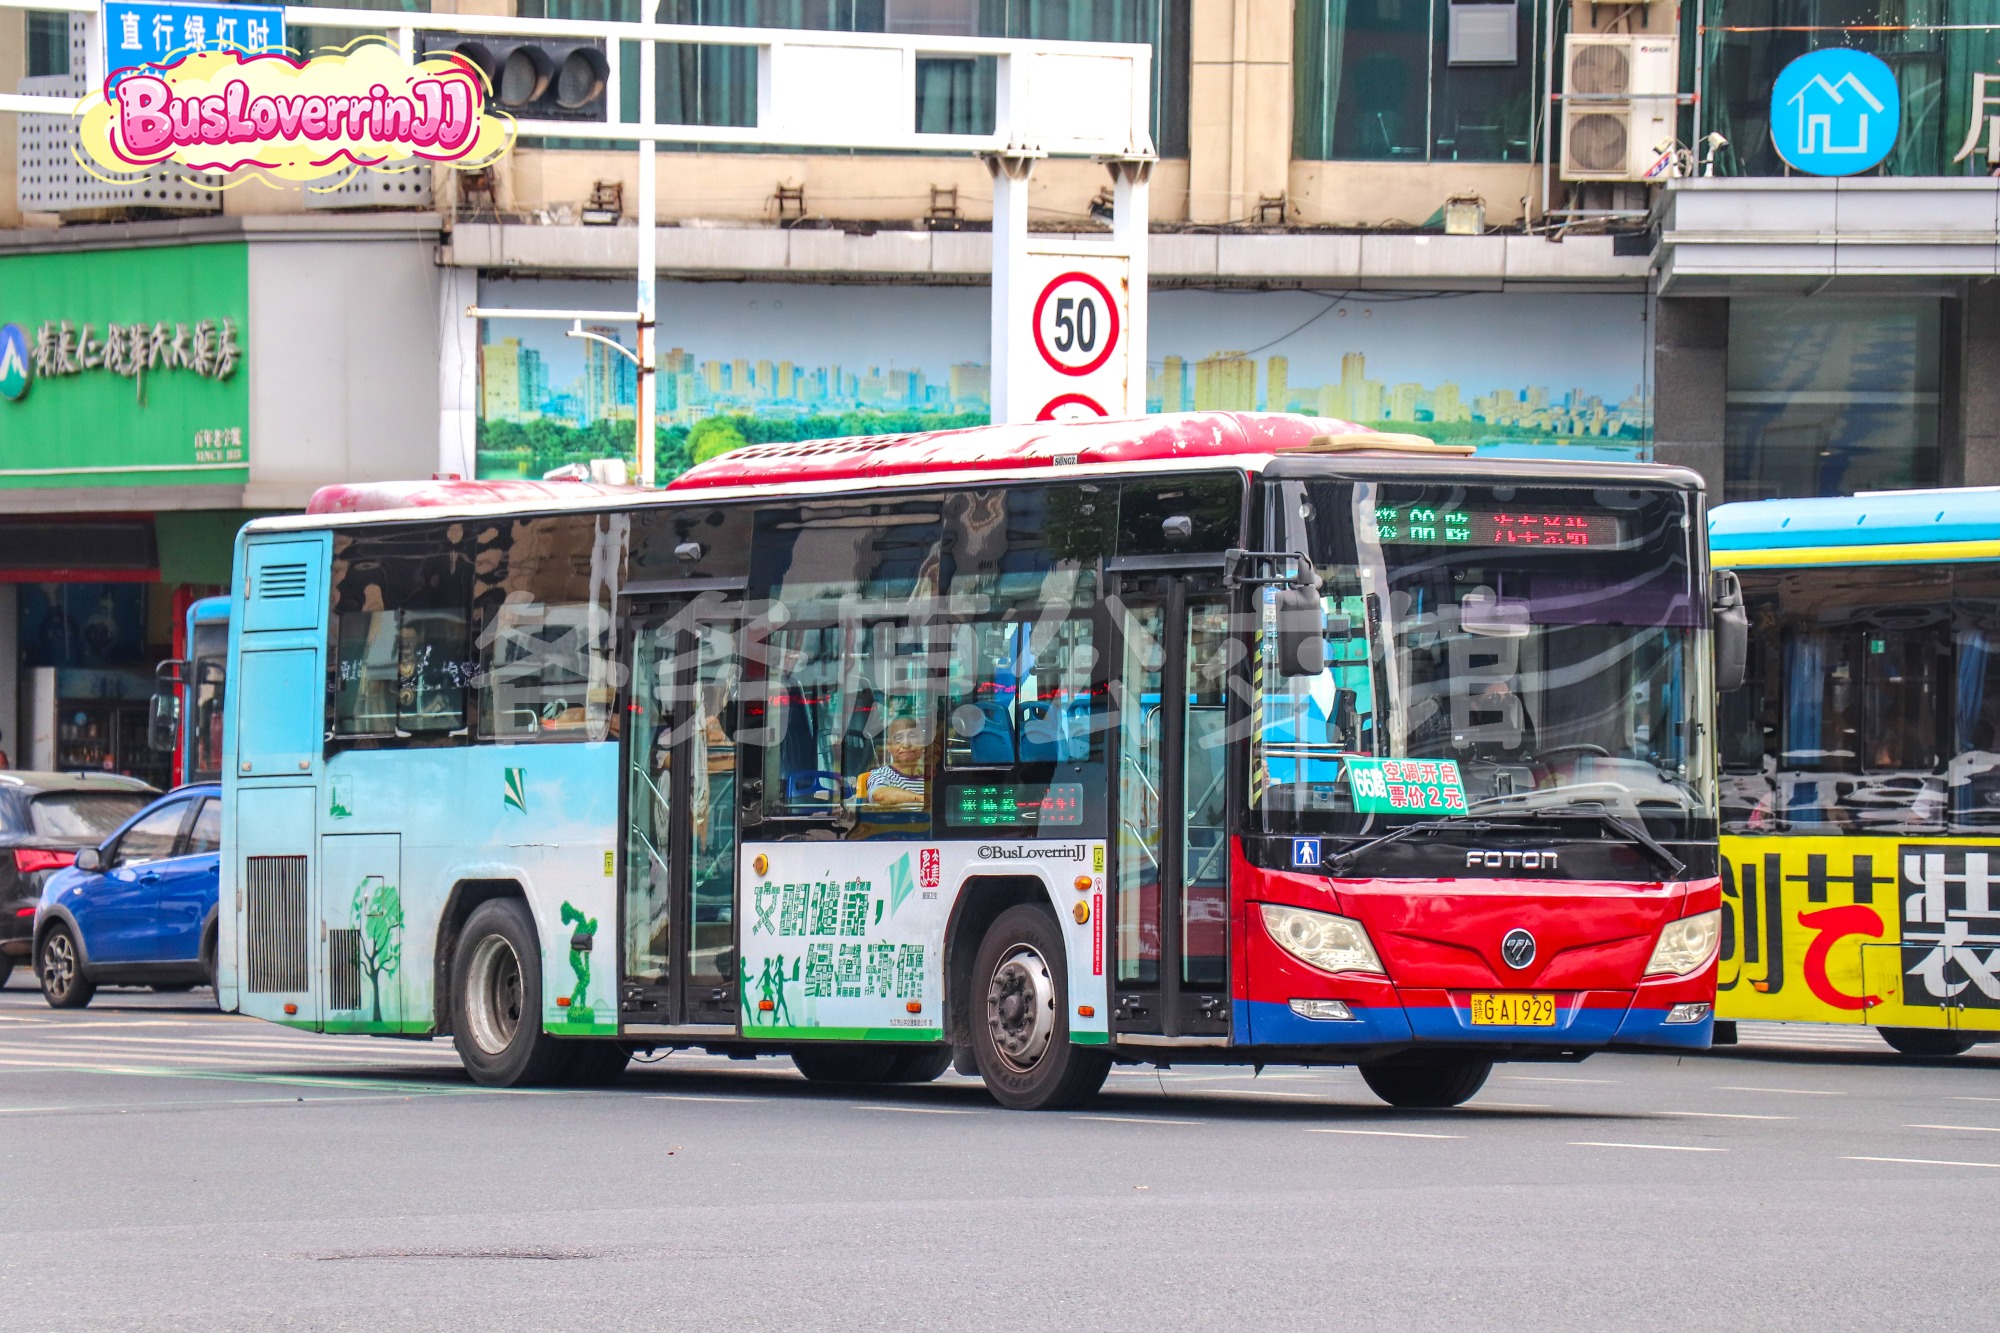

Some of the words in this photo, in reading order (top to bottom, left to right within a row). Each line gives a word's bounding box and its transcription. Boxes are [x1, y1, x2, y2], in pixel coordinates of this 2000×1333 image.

[120, 11, 270, 55] 直行绿灯时
[1054, 297, 1096, 353] 50
[1353, 767, 1388, 798] 66路
[1383, 761, 1459, 785] 空调开启
[1388, 784, 1464, 808] 票价2元
[1466, 851, 1558, 869] FOTON
